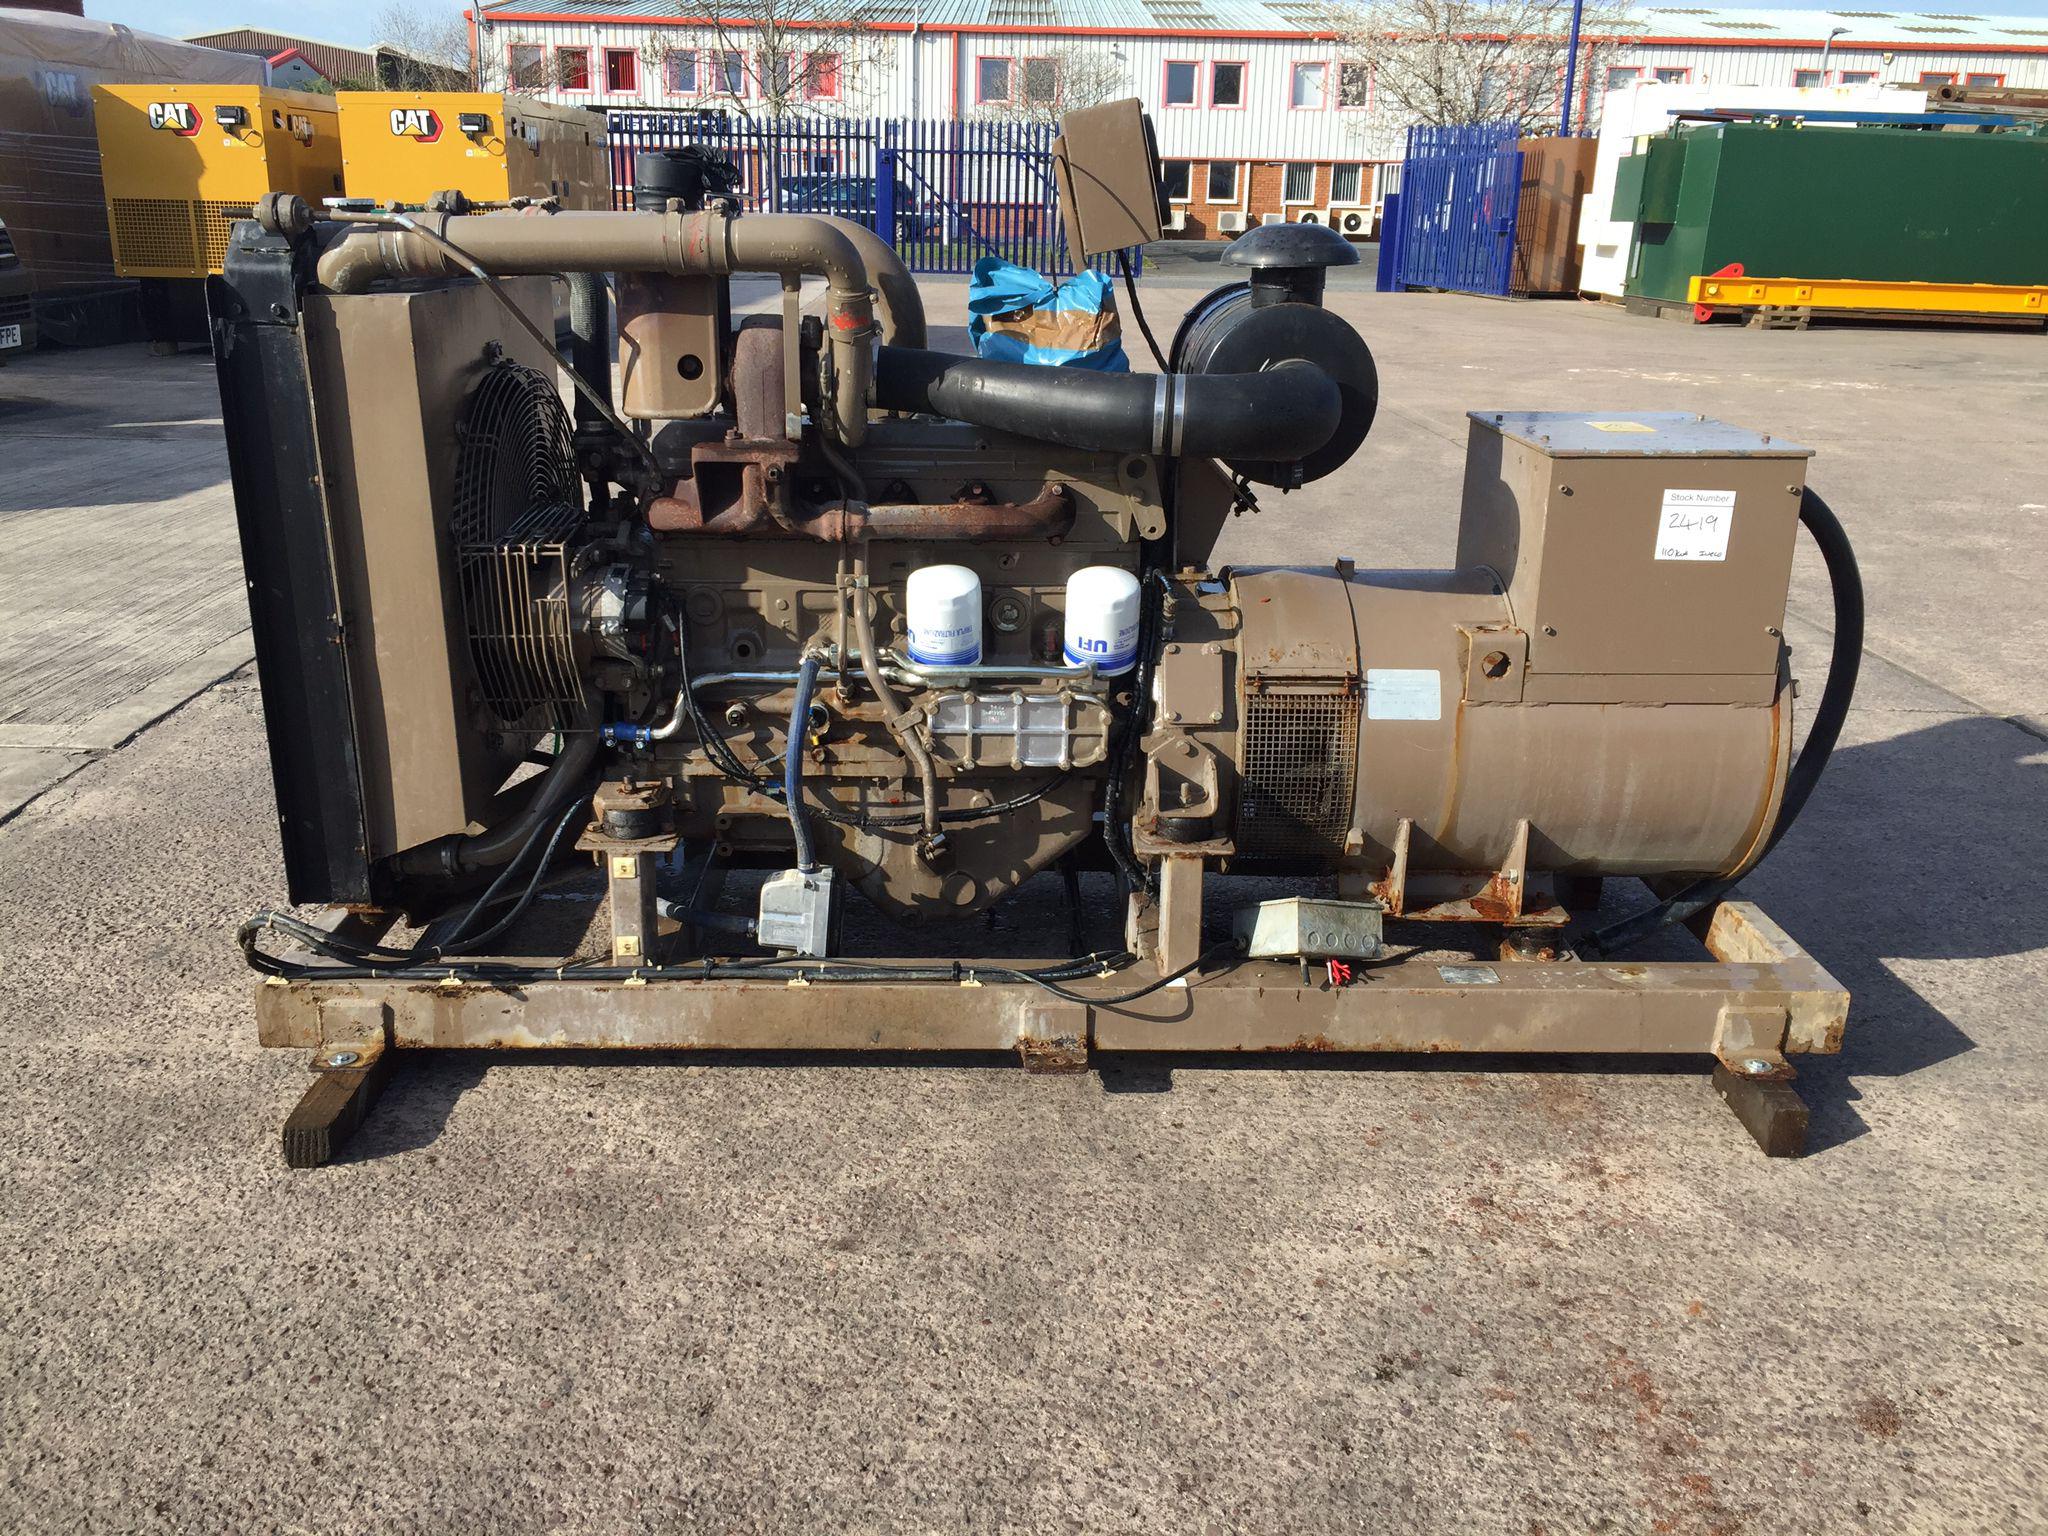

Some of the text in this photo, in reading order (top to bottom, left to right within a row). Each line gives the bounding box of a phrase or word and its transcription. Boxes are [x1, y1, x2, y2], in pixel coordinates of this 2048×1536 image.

[149, 103, 189, 129] CAT
[390, 109, 430, 135] CAT
[292, 115, 308, 140] CAT
[1671, 493, 1730, 502] Stock Number
[1669, 513, 1718, 532] 2419
[1078, 636, 1108, 653] UFI
